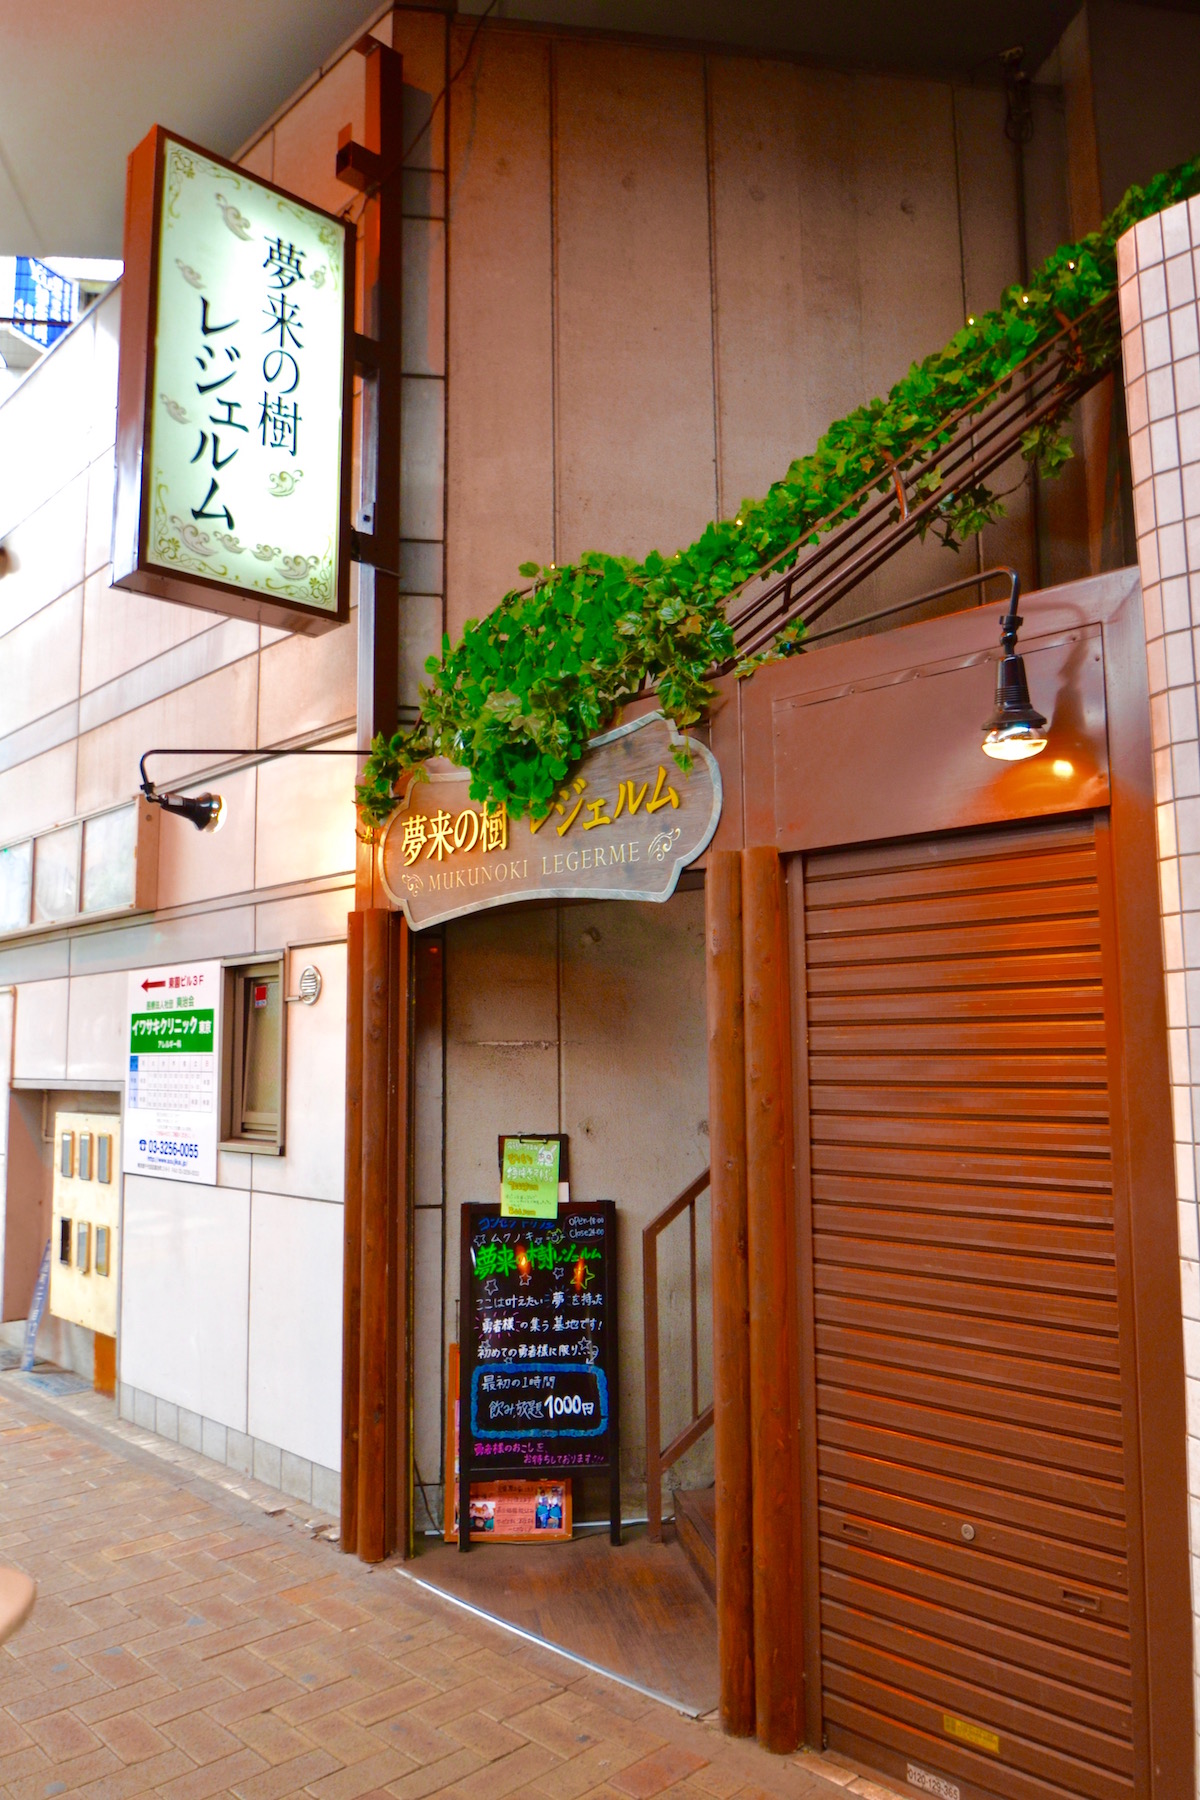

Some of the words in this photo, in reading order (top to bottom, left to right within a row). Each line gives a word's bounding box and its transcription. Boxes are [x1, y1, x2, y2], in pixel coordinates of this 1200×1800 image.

[257, 236, 306, 456] 夢来の樹
[190, 295, 249, 530] レジェルム
[401, 799, 508, 867] 夢来の樹
[429, 859, 529, 892] MUKUNOKI
[542, 841, 640, 876] LEGERME
[148, 1139, 199, 1158] 03-3256-0055
[481, 1374, 556, 1392] 最初の1時間
[908, 1768, 958, 1800] 0120-129-365
